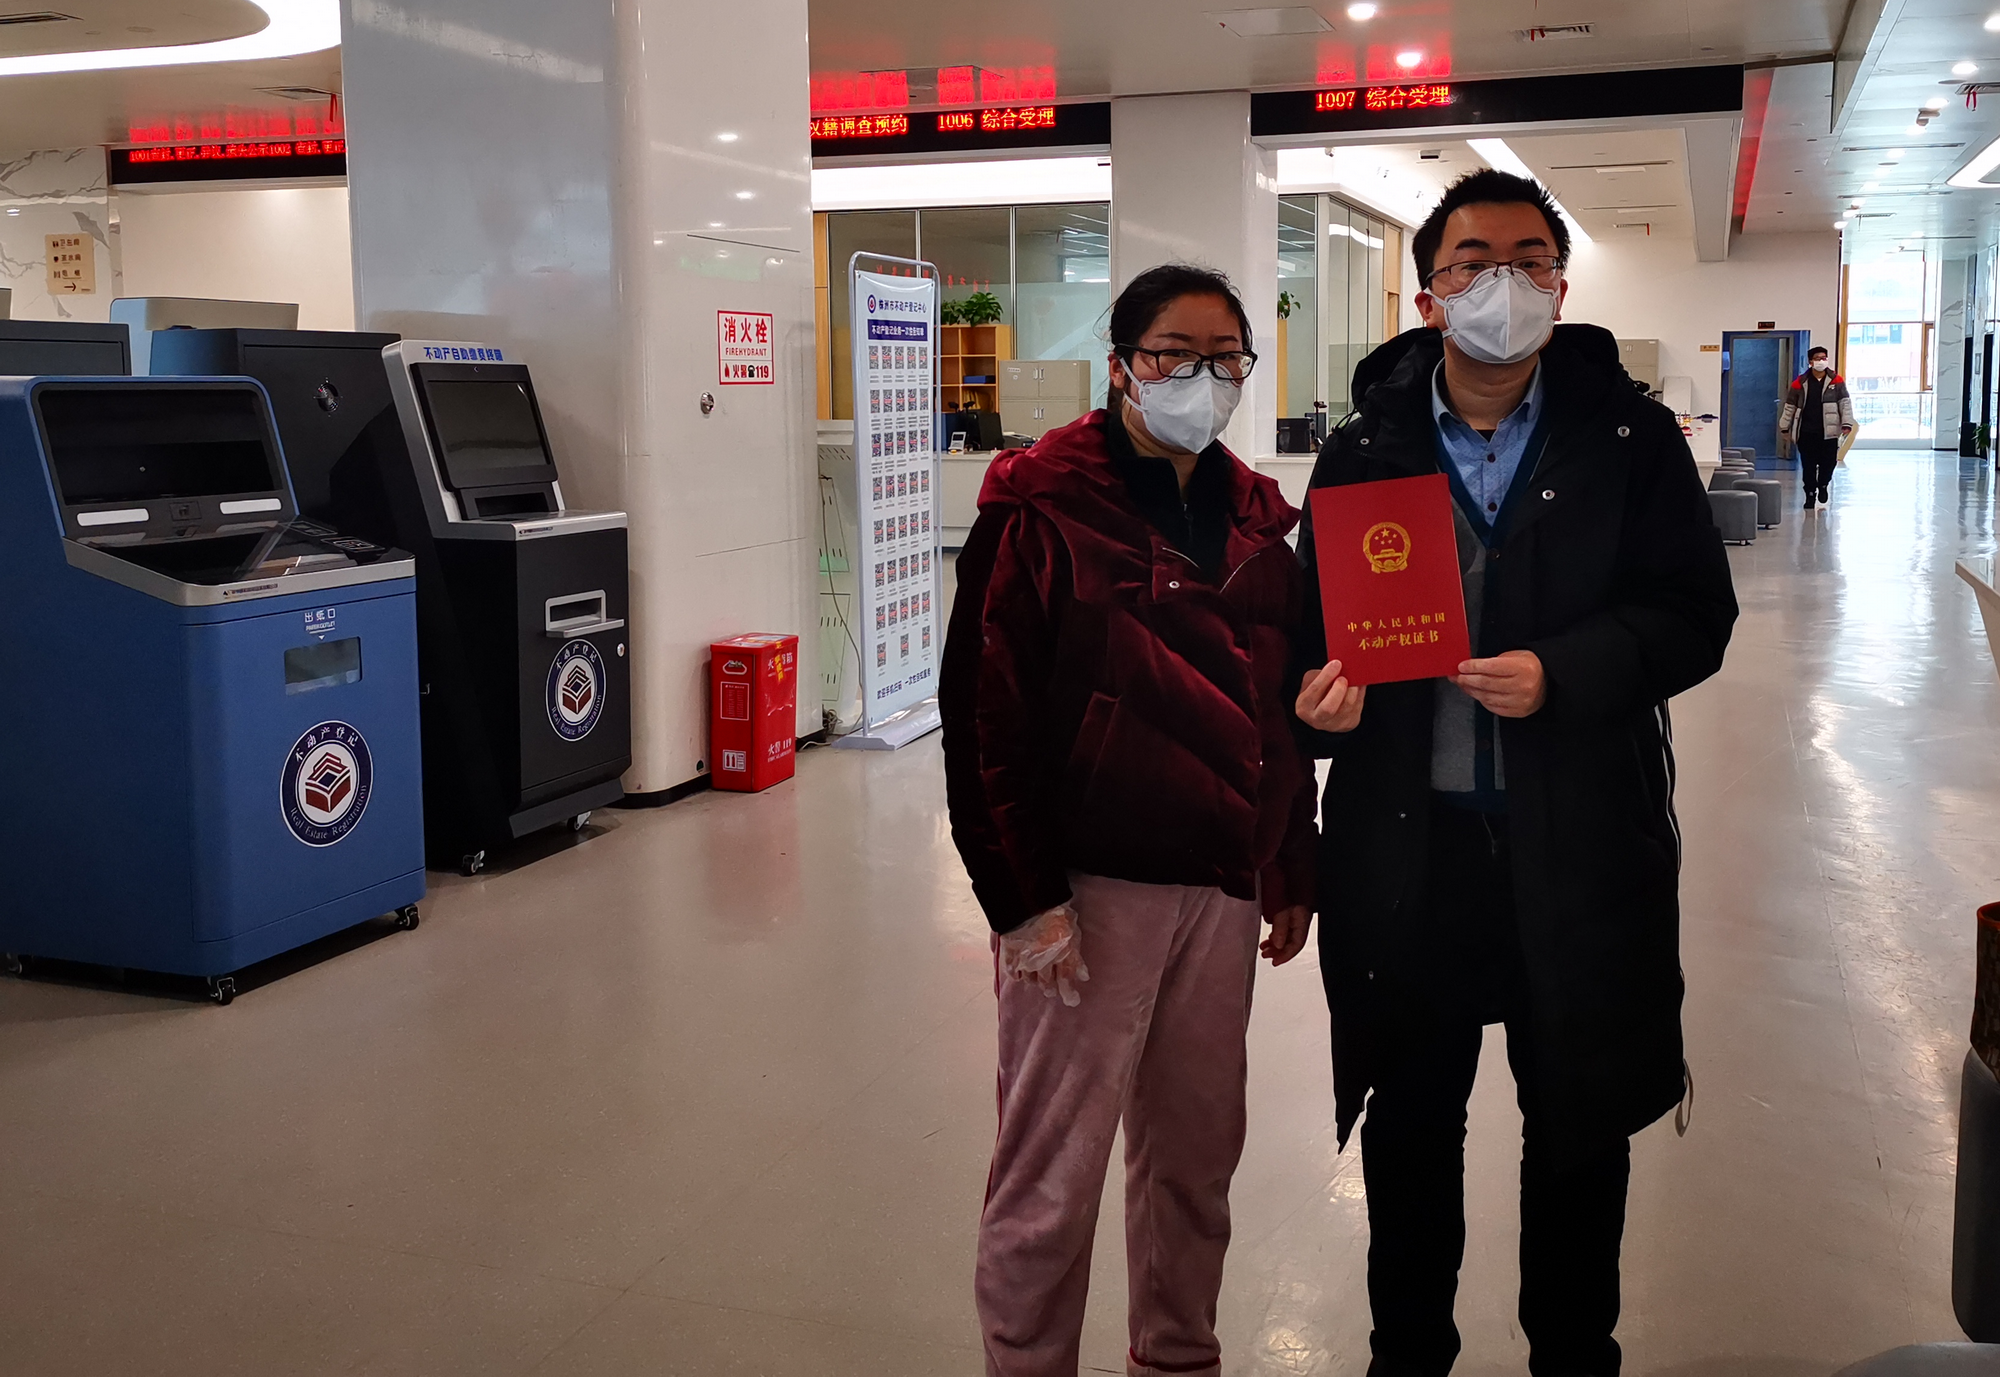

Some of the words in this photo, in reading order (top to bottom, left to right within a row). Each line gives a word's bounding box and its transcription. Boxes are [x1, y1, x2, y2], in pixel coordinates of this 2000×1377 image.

[1316, 91, 1356, 109] 1007
[1366, 84, 1449, 108] 综合受理
[938, 112, 974, 130] 1006
[981, 107, 1055, 129] 综合受理
[724, 316, 767, 344] 消火栓
[725, 347, 767, 356] FIREHYDRANT
[732, 364, 747, 378] 火警
[755, 365, 769, 378] 119
[304, 608, 336, 623] 出纸口
[1347, 612, 1445, 633] 中华人民共和国
[1359, 630, 1439, 651] 不动产权证书
[295, 726, 358, 763] 不动产登记
[290, 806, 304, 830] Real
[305, 826, 328, 840] Estate
[332, 784, 367, 836] Registration
